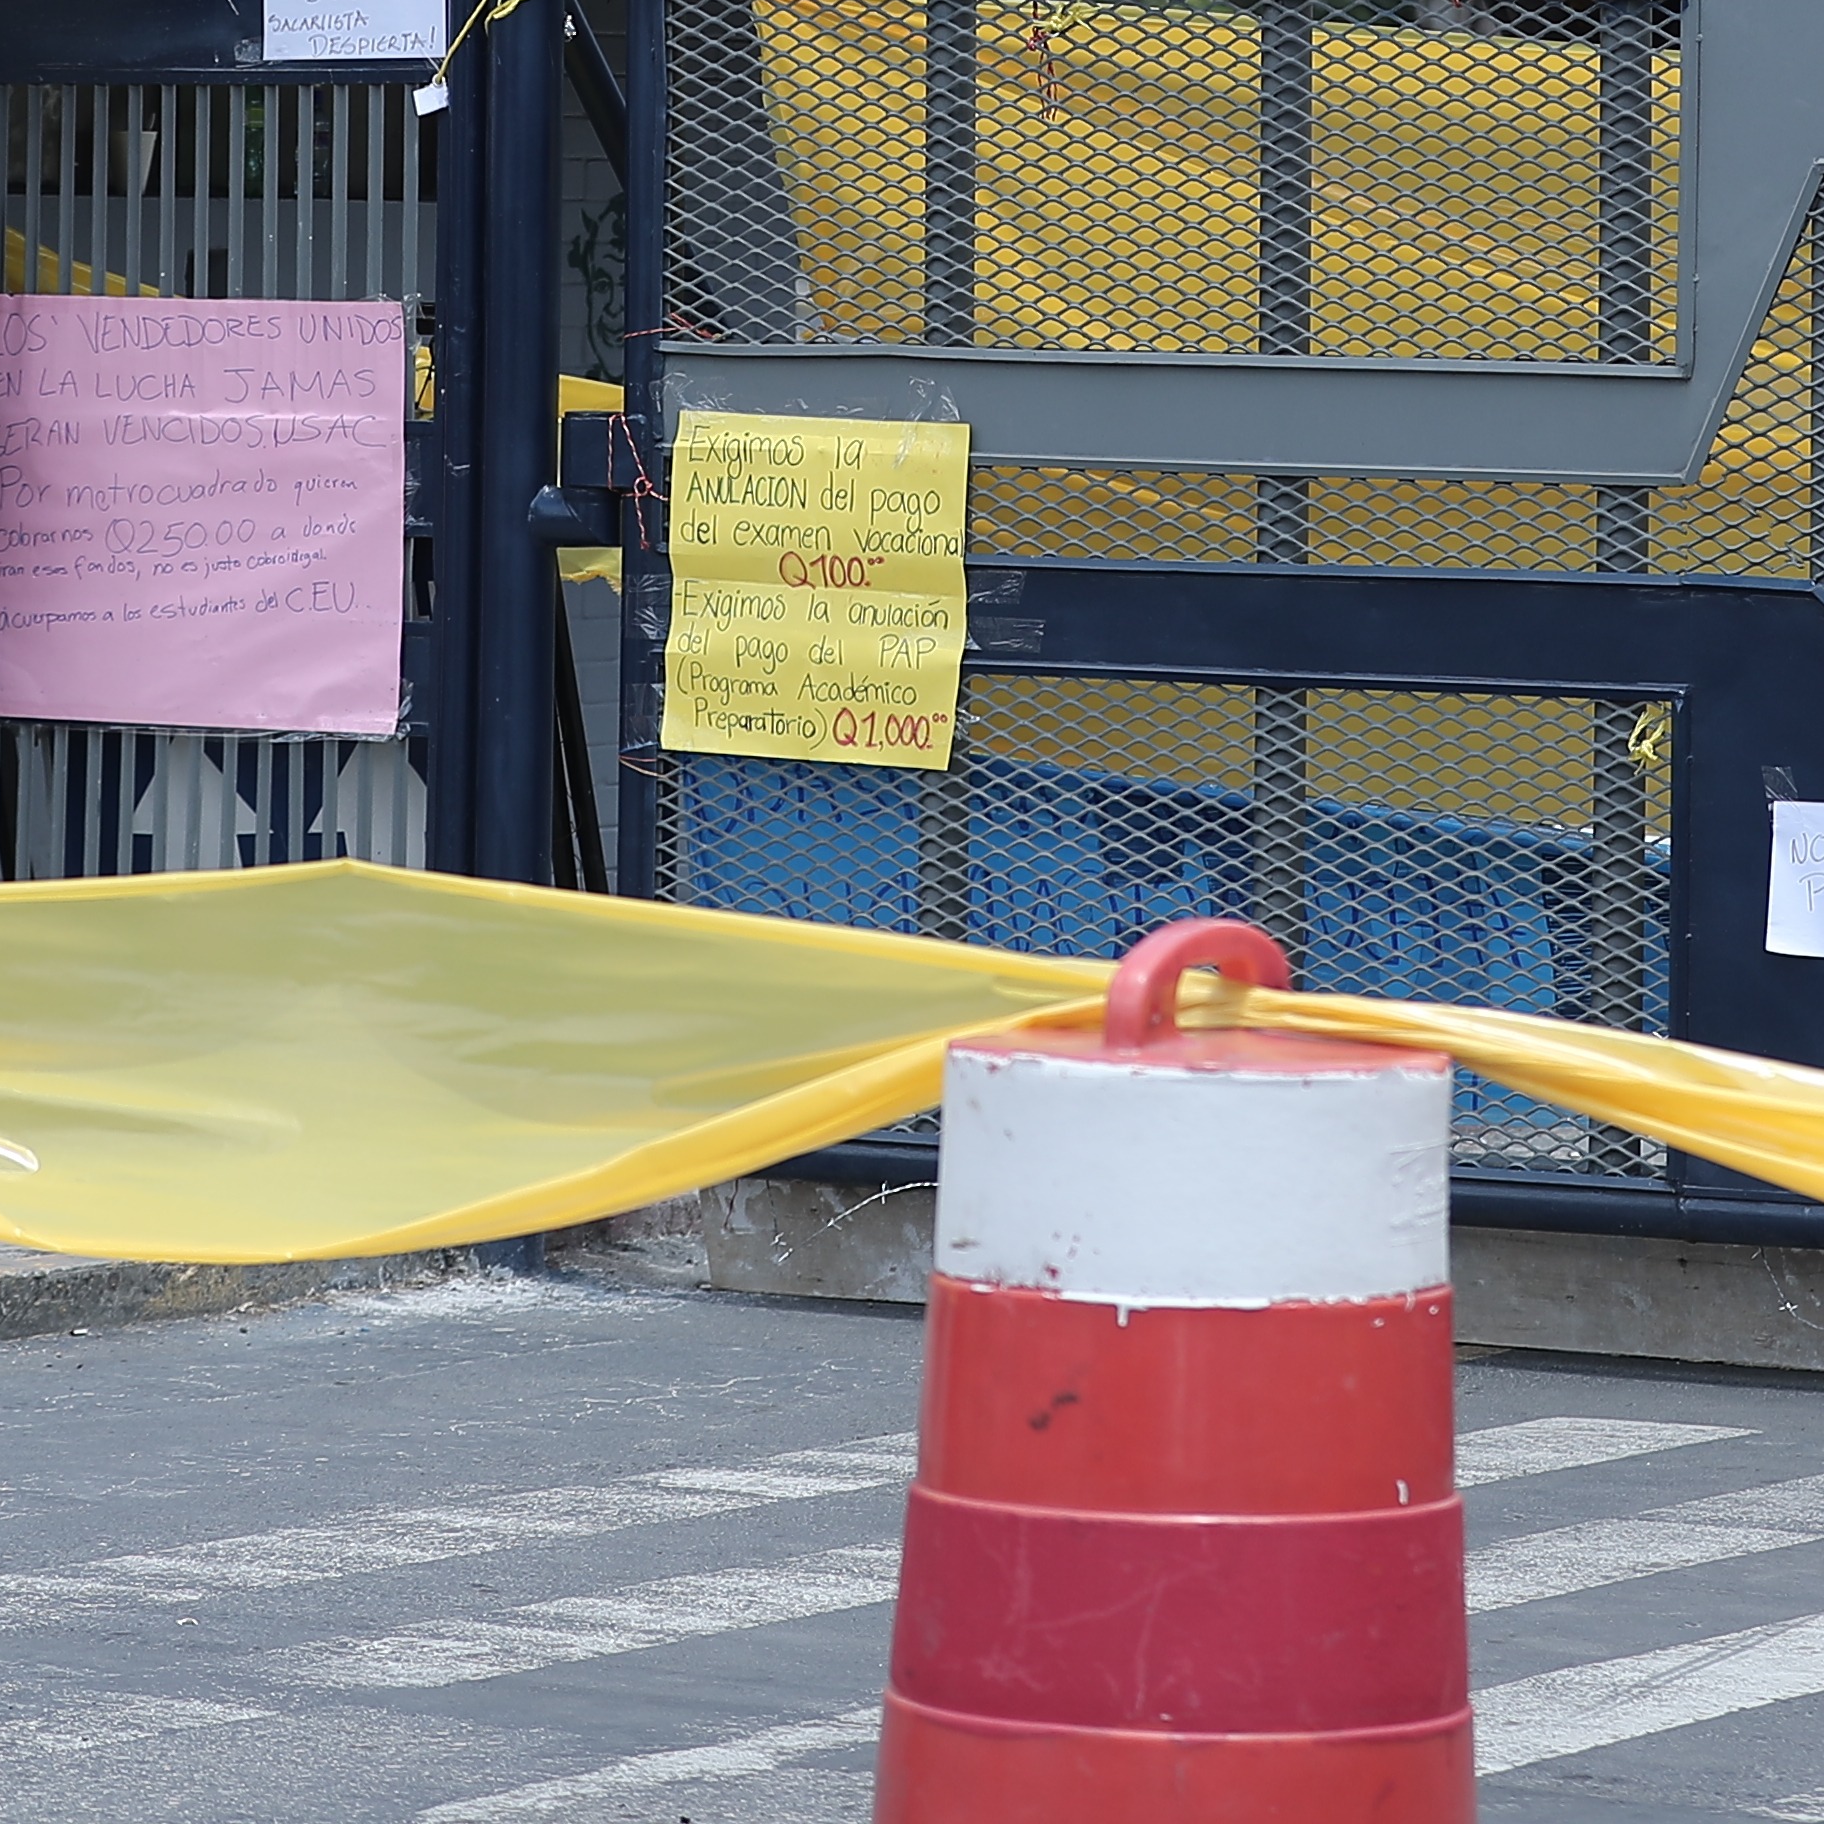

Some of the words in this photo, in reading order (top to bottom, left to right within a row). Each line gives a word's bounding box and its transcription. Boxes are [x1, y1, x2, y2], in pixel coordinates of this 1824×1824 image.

[77, 312, 282, 354] VENDEDORES
[299, 314, 403, 347] UNIDOS
[38, 368, 77, 398] LA
[95, 372, 196, 401] LUCHA
[223, 367, 376, 404] JAMAS
[835, 435, 864, 471] la
[293, 476, 358, 507] quieren
[686, 472, 808, 511] ANULACION
[819, 471, 855, 513] del
[870, 487, 941, 533] pago
[270, 522, 287, 540] a
[680, 510, 717, 546] del
[733, 520, 831, 551] examen
[854, 527, 965, 558] vocacional
[152, 562, 174, 576] no
[181, 561, 198, 572] es
[102, 612, 115, 622] a
[123, 603, 142, 622] los
[150, 594, 246, 619] estudiantes
[255, 589, 279, 613] del
[807, 593, 830, 623] la
[848, 599, 948, 631] anulación
[677, 622, 709, 657] del
[735, 633, 789, 675] pago
[808, 635, 844, 666] del
[877, 633, 938, 670] PAP
[797, 673, 918, 706] Académico
